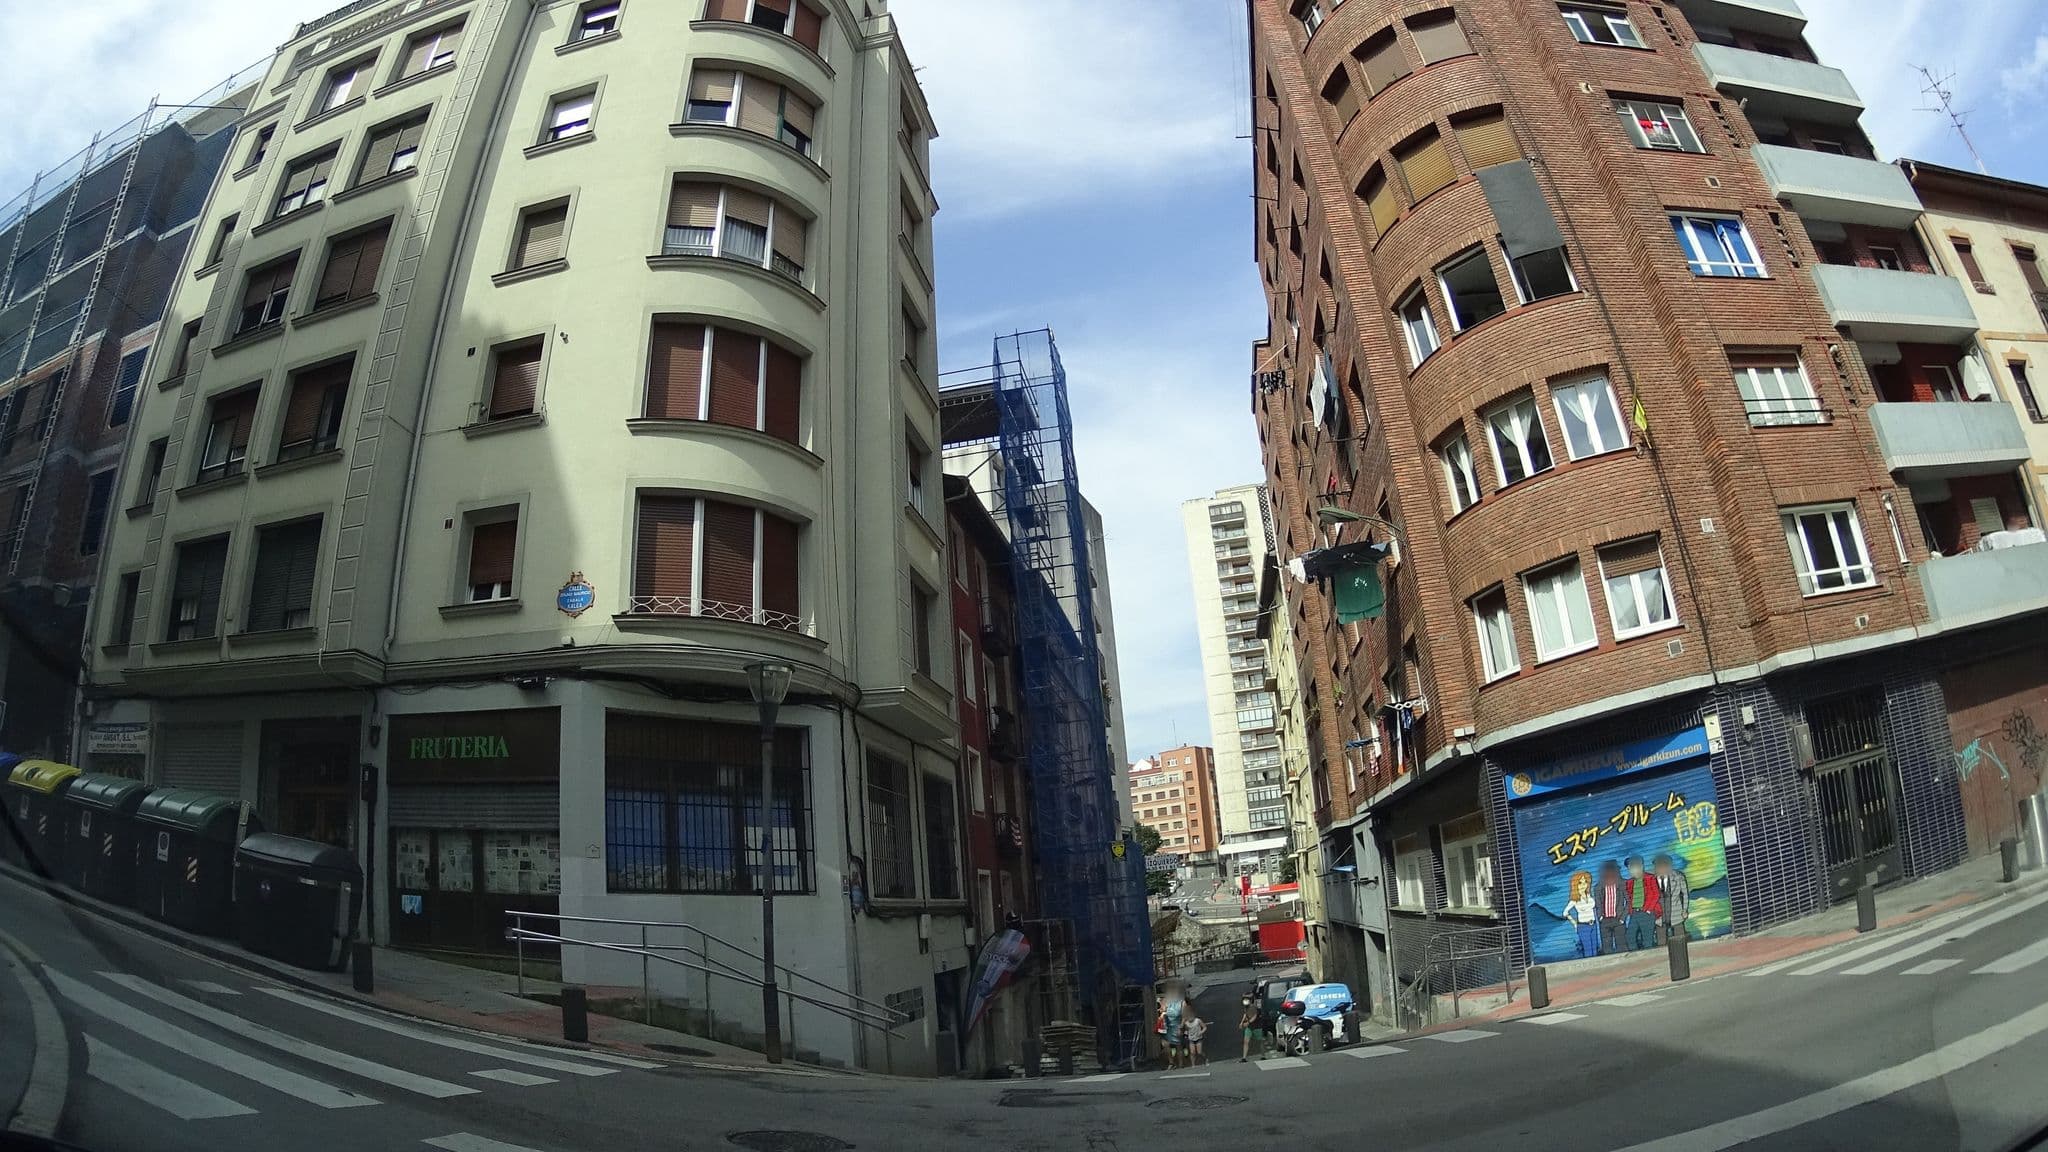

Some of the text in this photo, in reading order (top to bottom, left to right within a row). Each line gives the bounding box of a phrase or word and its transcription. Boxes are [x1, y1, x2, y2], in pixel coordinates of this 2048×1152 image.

[410, 735, 510, 760] FRUTERIA
[1616, 742, 1703, 772] www.igarkizun.com
[1548, 791, 1686, 865] エスケープルーム
